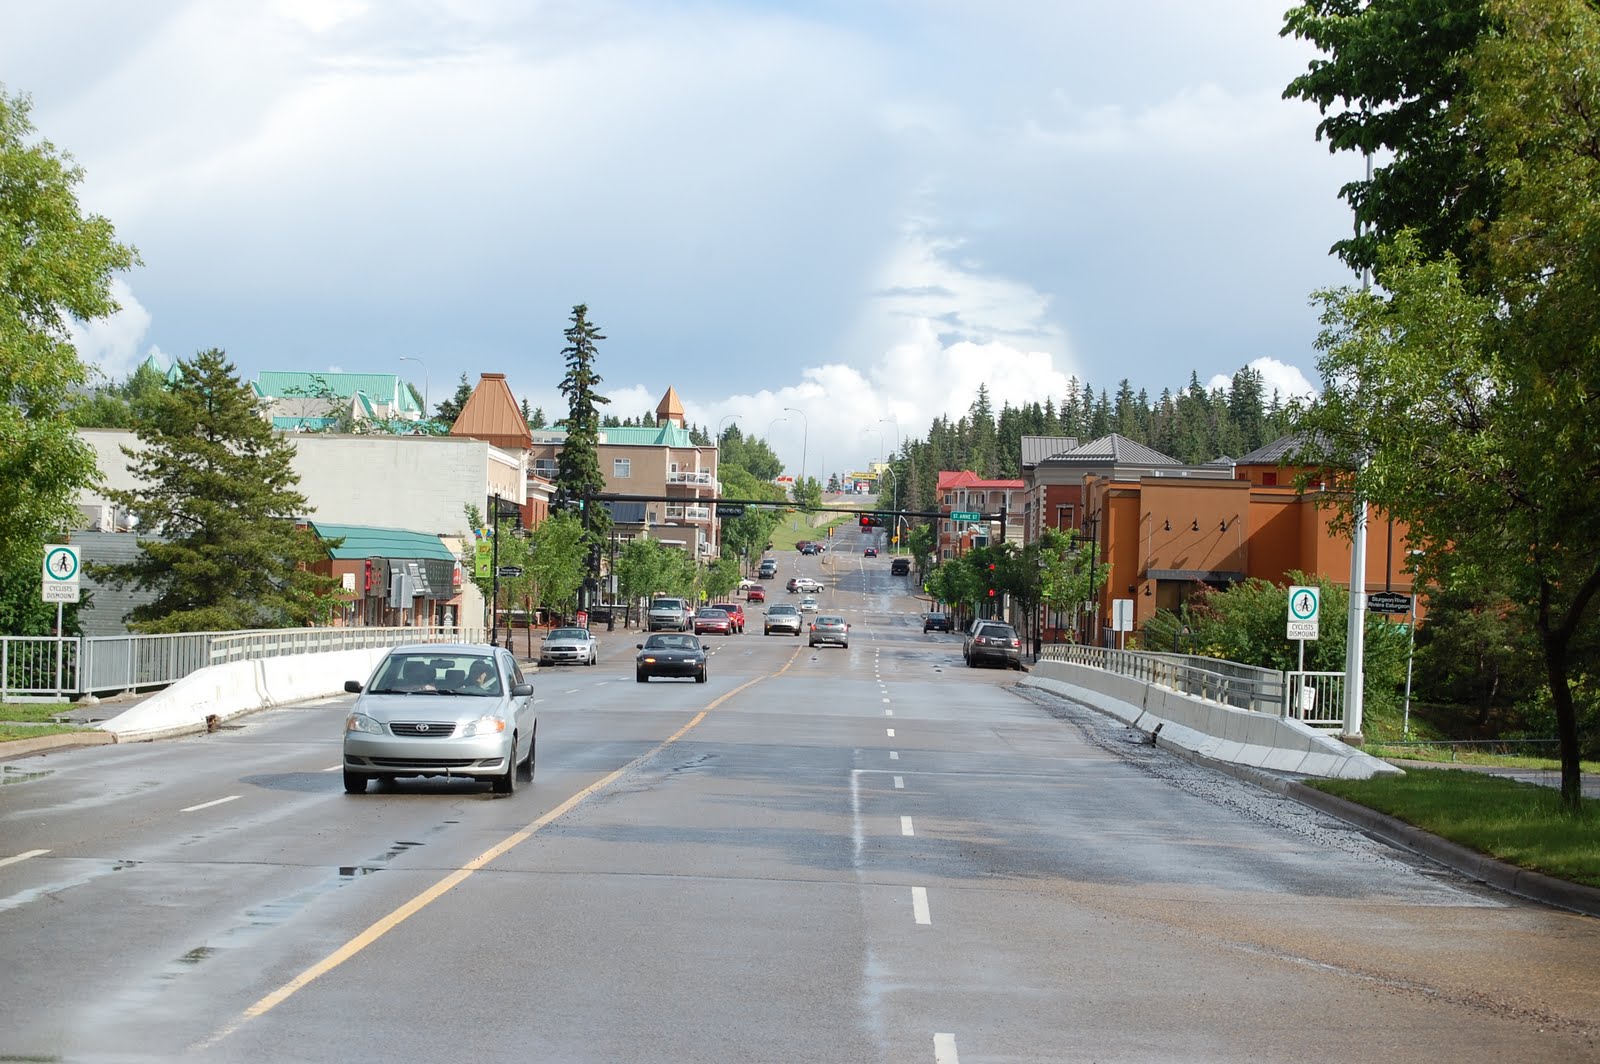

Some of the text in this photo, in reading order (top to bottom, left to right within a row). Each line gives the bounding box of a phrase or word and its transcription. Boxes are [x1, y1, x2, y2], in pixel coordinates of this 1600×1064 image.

[1371, 596, 1394, 604] Sturgeon
[1291, 623, 1314, 631] CYCLISTS
[1289, 630, 1316, 638] DISMOUNT
